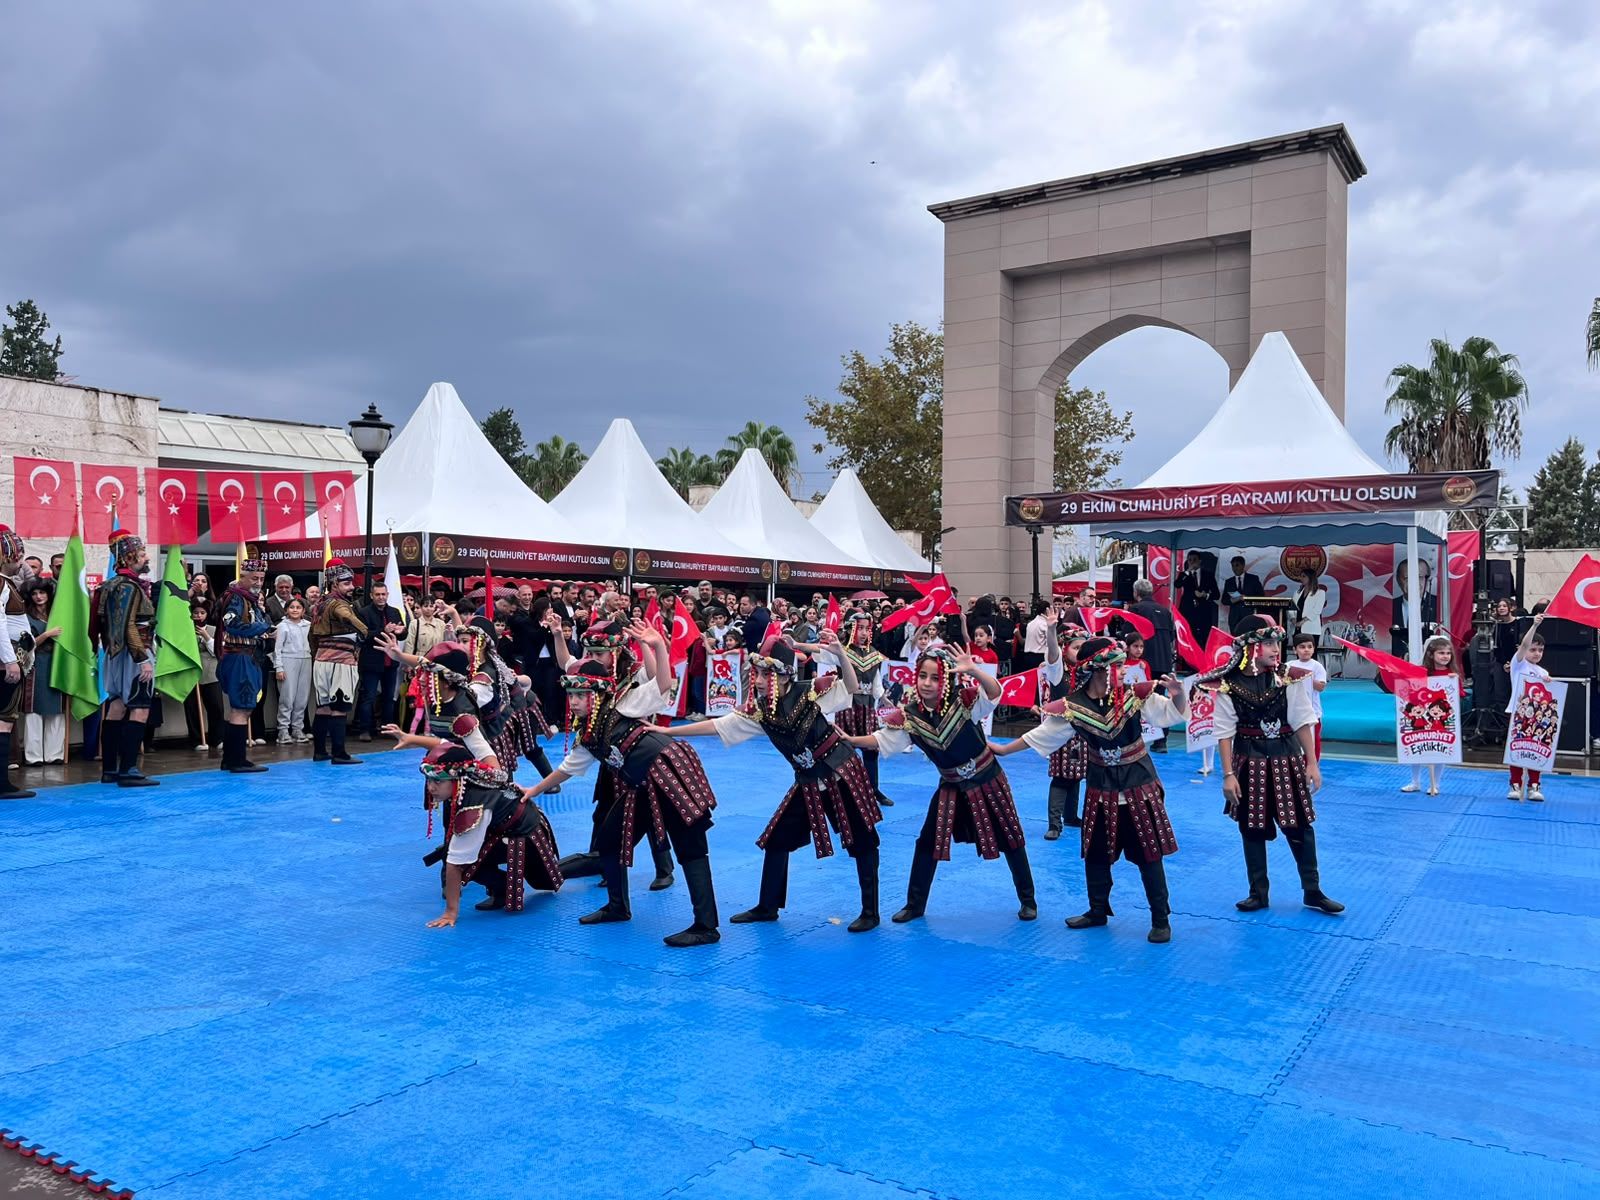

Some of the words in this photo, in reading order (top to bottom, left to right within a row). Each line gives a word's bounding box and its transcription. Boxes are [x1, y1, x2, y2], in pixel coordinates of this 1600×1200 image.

[1061, 502, 1077, 514] 29
[1082, 499, 1116, 513] EKİM
[1119, 494, 1217, 512] CUMHURİYET
[1221, 490, 1292, 507] BAYRAMI
[1296, 488, 1351, 503] KUTLU
[1356, 486, 1417, 501] OLSUN
[261, 552, 268, 560] 29
[268, 550, 283, 560] EKİM
[284, 548, 323, 559] CUMHURİYET
[375, 546, 398, 556] OLSN
[457, 547, 467, 557] 29
[490, 549, 537, 561] CUMHURİYET
[538, 552, 568, 563] BAYRAMI
[568, 555, 589, 564] KUTLU
[590, 556, 610, 565] OLSUN
[660, 560, 674, 569] EKİM
[674, 562, 708, 571] CUMHURİYET
[1404, 730, 1454, 744] CUMHURİYET
